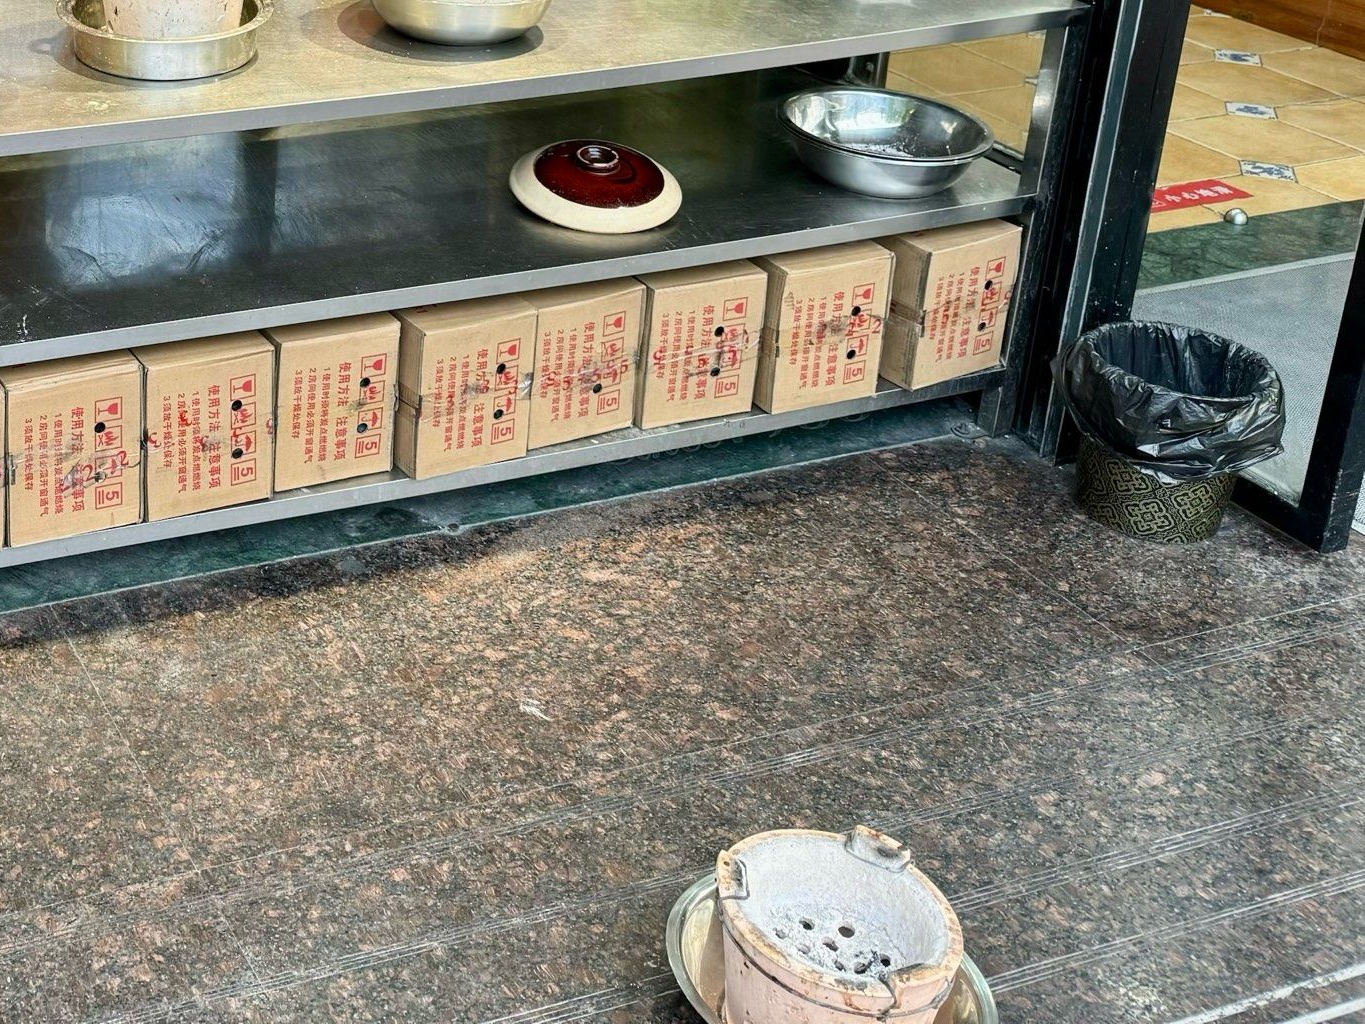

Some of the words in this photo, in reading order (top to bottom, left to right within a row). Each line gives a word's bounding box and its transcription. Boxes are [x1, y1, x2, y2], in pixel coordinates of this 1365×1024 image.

[701, 305, 714, 347] 使用方法
[958, 317, 973, 358] 注意事项
[980, 339, 991, 348] 5
[337, 362, 351, 407] 使用方法
[826, 344, 839, 386] 注意事项
[850, 368, 863, 377] 5
[605, 398, 617, 407] 5
[724, 382, 736, 391] 5
[209, 385, 220, 432] 使用方法
[471, 403, 485, 448] 注意事项
[71, 407, 84, 454] 使用方法
[334, 416, 348, 460] 注意事项
[364, 442, 377, 451] 5
[500, 427, 512, 436] 5
[208, 442, 220, 488] 注意事项
[240, 468, 253, 478] 5
[105, 491, 119, 501] 5
